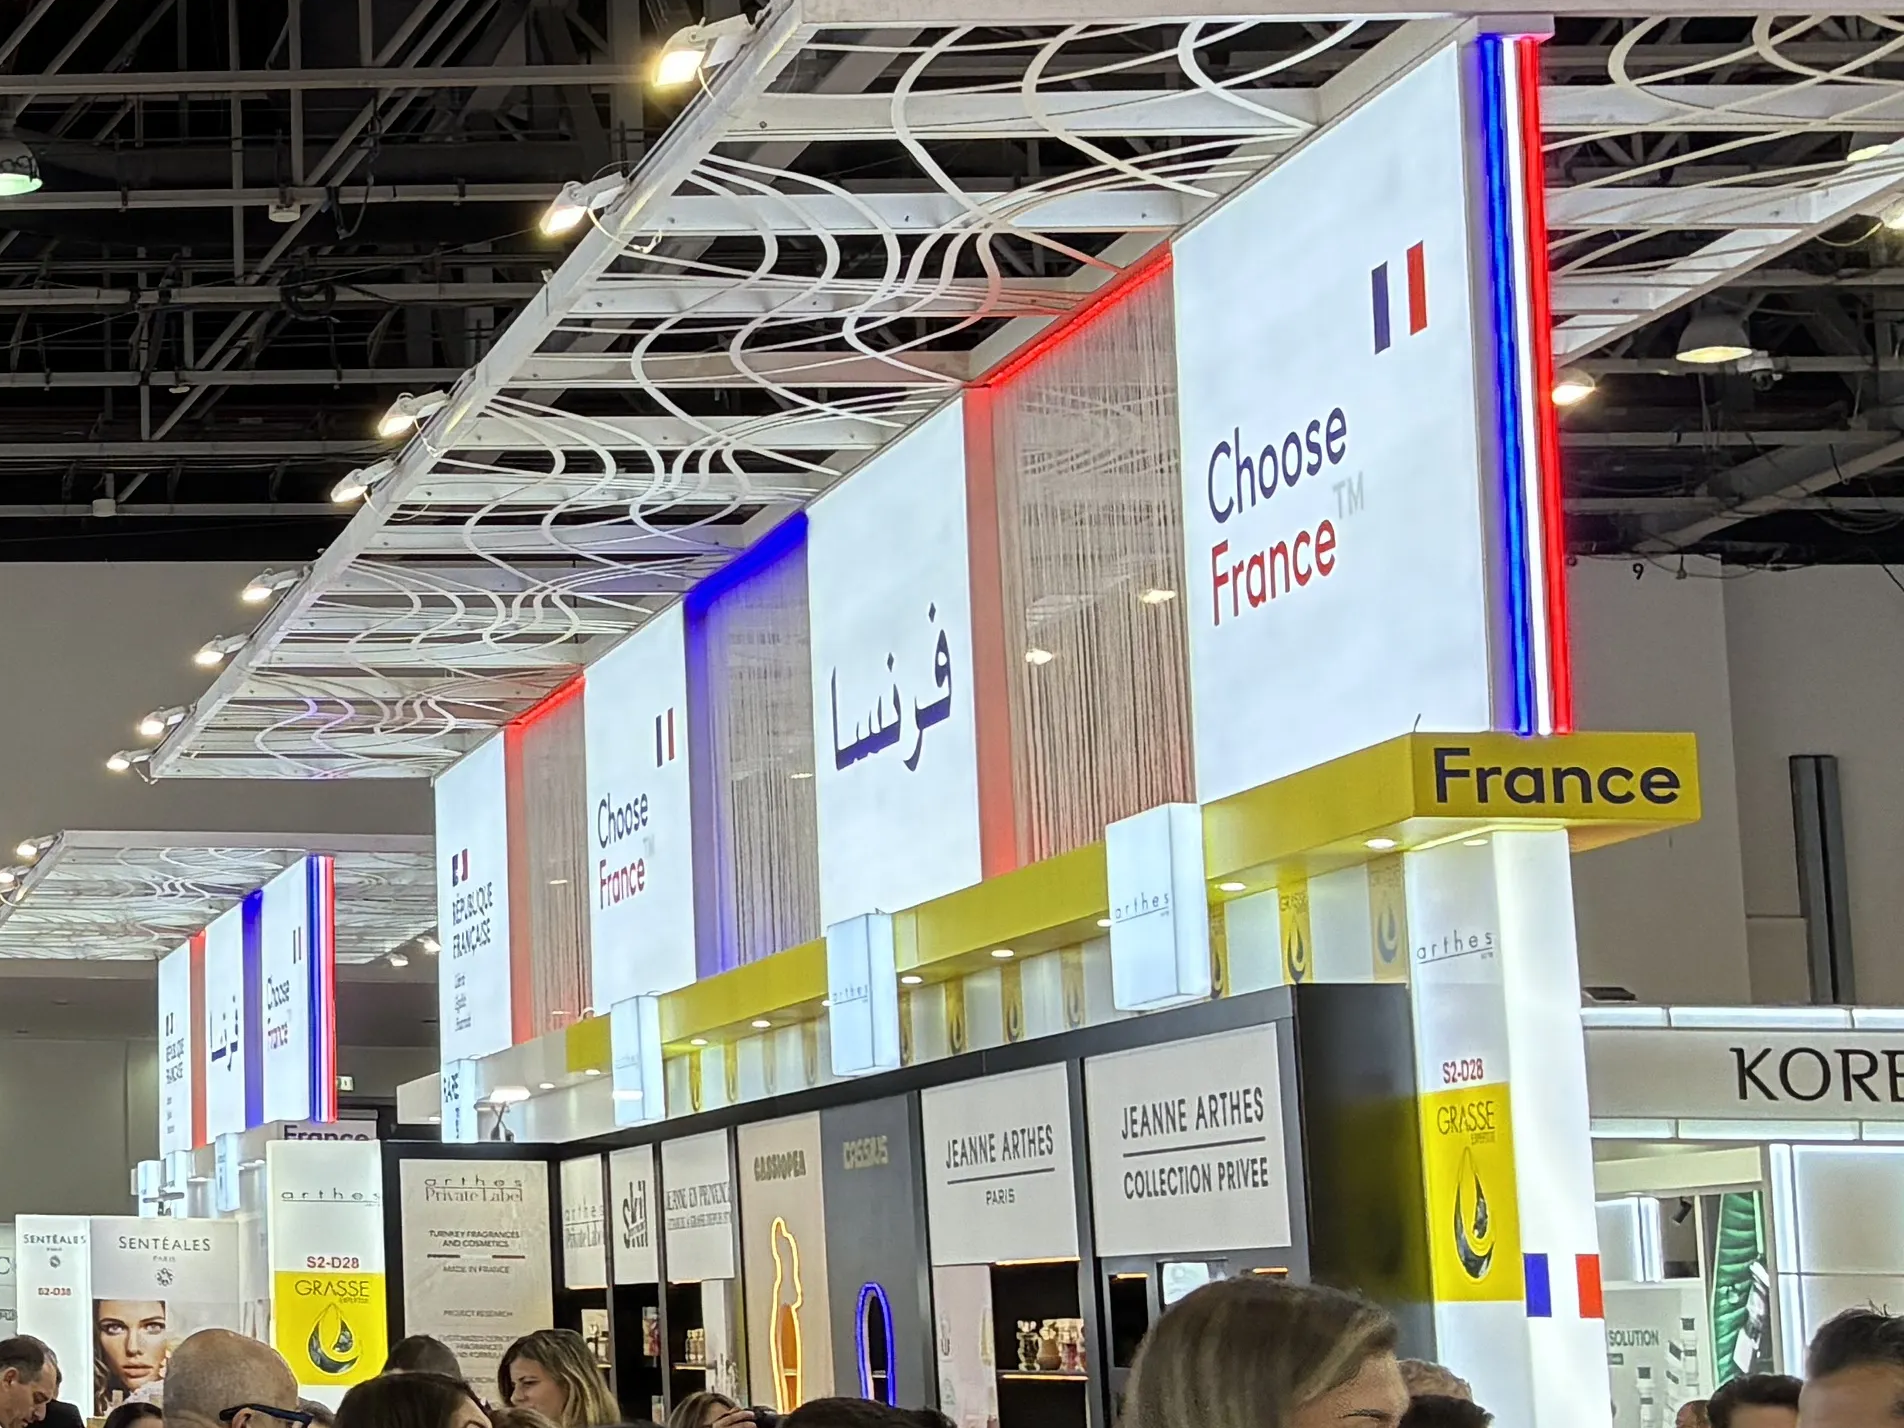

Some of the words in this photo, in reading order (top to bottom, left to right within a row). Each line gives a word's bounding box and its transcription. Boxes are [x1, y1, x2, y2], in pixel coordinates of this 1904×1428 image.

[1205, 404, 1347, 524] Choose
[1209, 516, 1338, 627] France
[828, 601, 955, 773] فرنسا
[1433, 747, 1681, 805] France
[595, 789, 650, 850] Choose
[596, 853, 648, 912] France
[1114, 892, 1169, 919] arthes
[1417, 930, 1493, 960] arthes
[1442, 1058, 1483, 1084] S2-D28
[1121, 1102, 1187, 1141] JEANNE
[1196, 1087, 1265, 1125] ARTHES
[1437, 1101, 1495, 1135] GRASSE
[944, 1133, 996, 1170] JEANNE
[1001, 1123, 1055, 1161] ARTHES
[425, 1175, 522, 1187] arthes
[425, 1187, 479, 1202] Private
[483, 1187, 523, 1202] Label
[1123, 1162, 1213, 1201] COLLECTION
[1217, 1156, 1270, 1193] PRIVEE
[984, 1187, 1016, 1208] PARIS
[119, 1236, 210, 1251] SENTÉALES
[306, 1256, 359, 1269] S2-D28
[294, 1280, 369, 1297] GRASSE
[1608, 1329, 1659, 1346] SOLUTION
